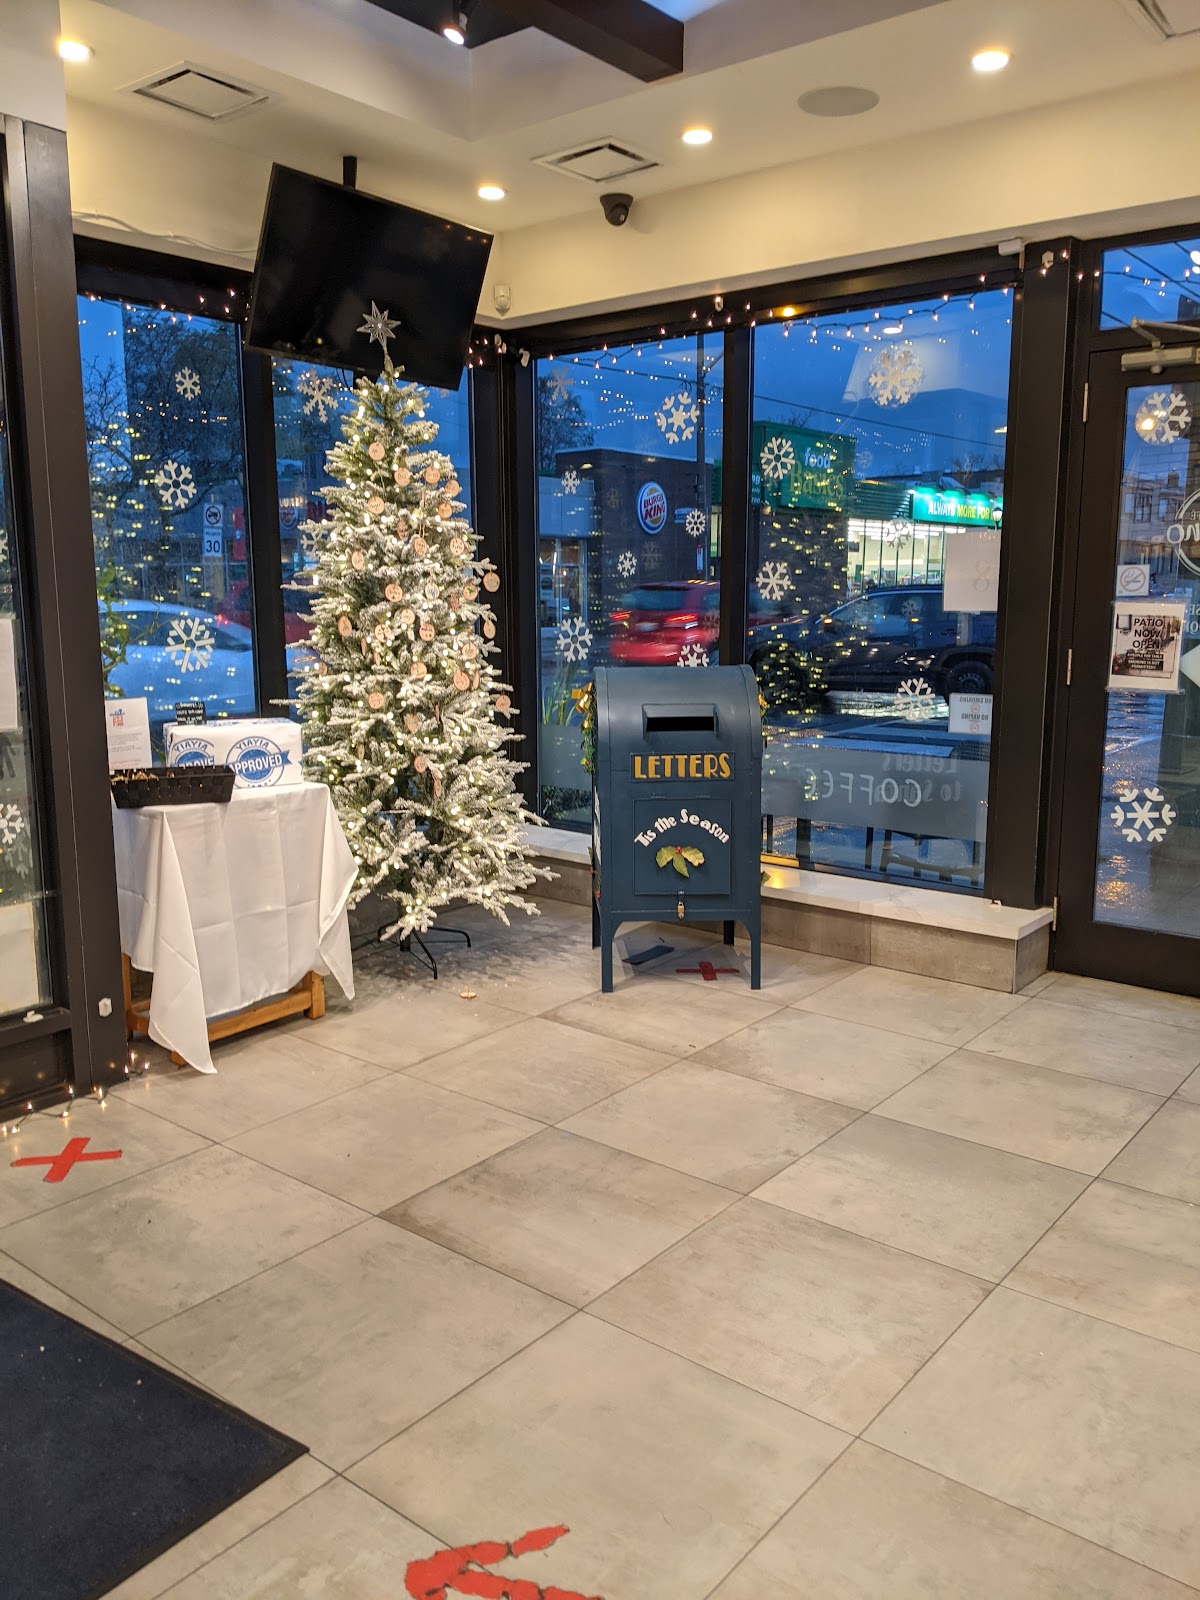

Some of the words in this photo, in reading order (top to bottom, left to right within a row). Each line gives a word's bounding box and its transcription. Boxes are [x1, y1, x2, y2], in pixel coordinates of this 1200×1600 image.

[804, 447, 832, 469] food
[788, 460, 845, 498] Basics
[928, 500, 956, 517] ALWAYS
[956, 504, 976, 519] MORE
[977, 506, 991, 520] FOR
[206, 540, 220, 553] 30
[1133, 618, 1164, 627] PATIO
[1134, 629, 1161, 638] NOW
[1132, 640, 1160, 649] OPEN
[174, 740, 208, 753] YIAYIA
[235, 739, 269, 752] YIAYIA
[634, 753, 731, 779] LETTERS
[654, 816, 677, 833] the
[680, 808, 730, 844] Season
